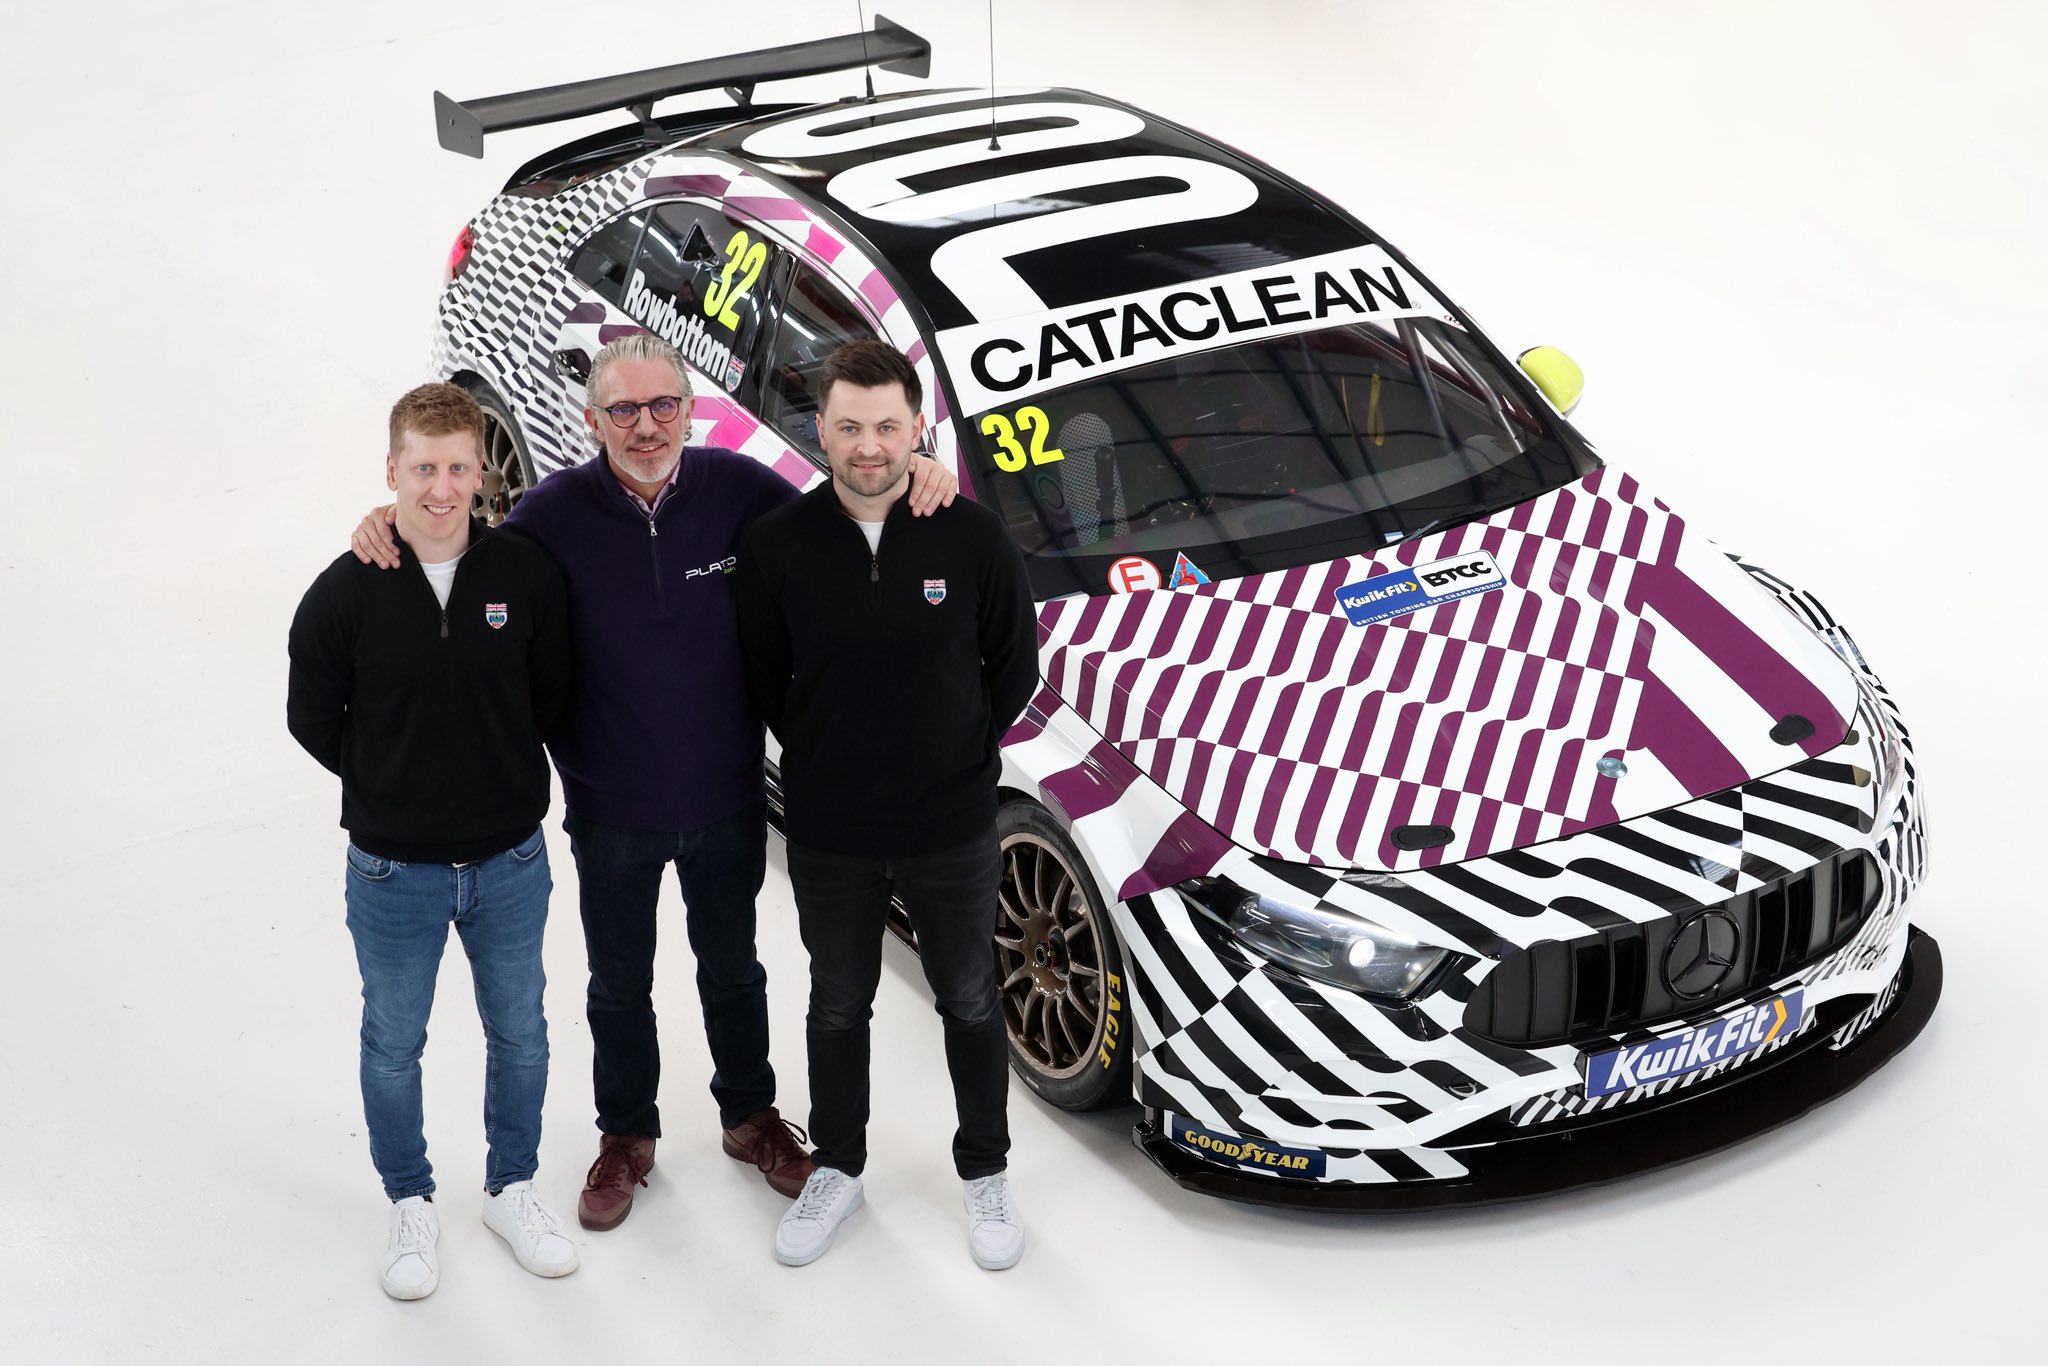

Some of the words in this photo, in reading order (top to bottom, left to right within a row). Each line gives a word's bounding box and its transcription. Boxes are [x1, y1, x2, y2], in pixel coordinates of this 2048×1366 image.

[704, 230, 767, 332] 32
[623, 268, 731, 382] Rowbottom
[970, 266, 1412, 392] CATACLEAN
[980, 405, 1065, 473] 32
[685, 556, 737, 580] PLATO
[1420, 561, 1492, 588] BTCC
[1355, 612, 1389, 626] BRITISH
[1389, 602, 1426, 616] TOURING
[1427, 596, 1444, 605] CAR
[1445, 581, 1503, 600] CHAMPIONSHIP
